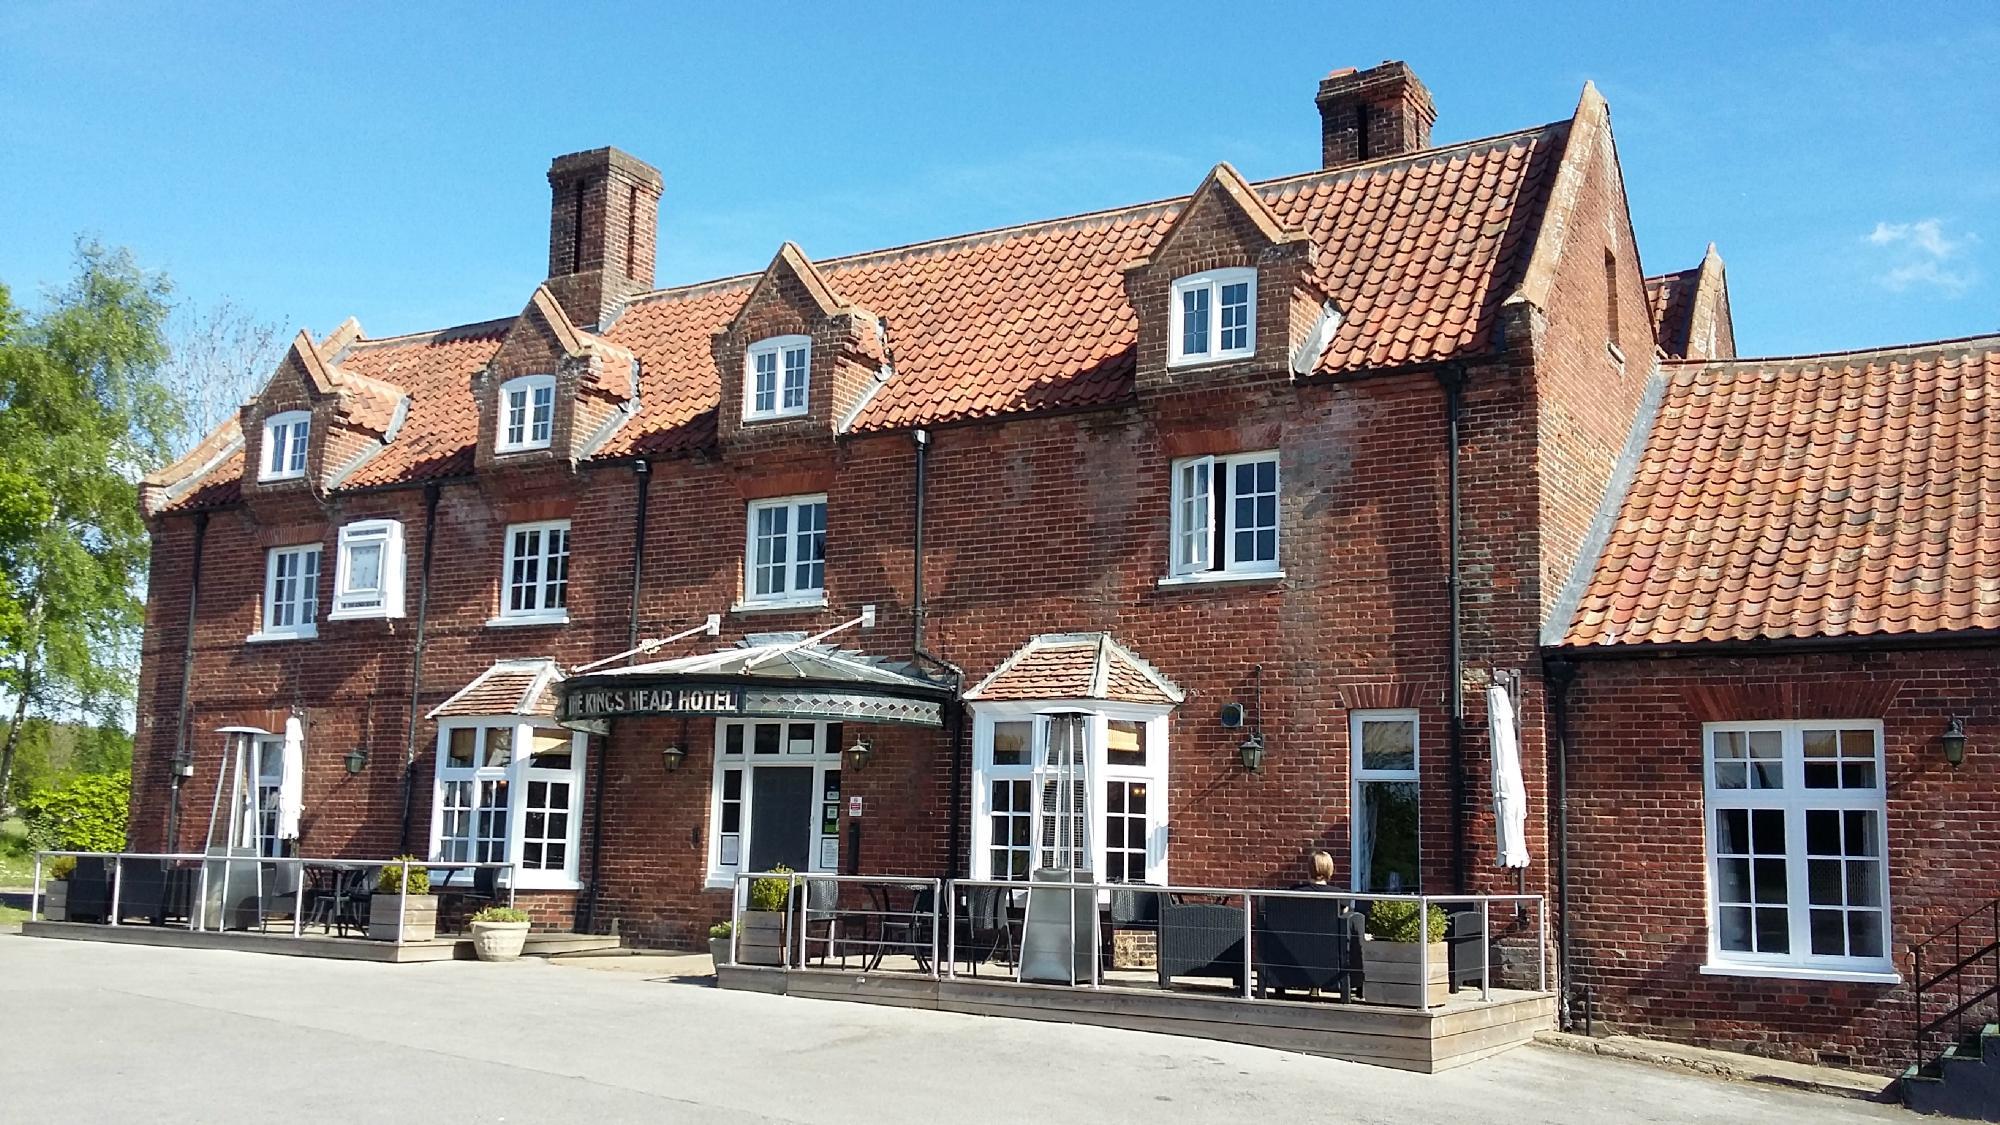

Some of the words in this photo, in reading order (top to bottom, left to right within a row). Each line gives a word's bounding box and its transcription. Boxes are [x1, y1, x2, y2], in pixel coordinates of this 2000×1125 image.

[569, 695, 583, 715] THE
[586, 692, 625, 713] KINGS
[629, 690, 673, 711] HEAD
[679, 690, 736, 711] HOTEL
